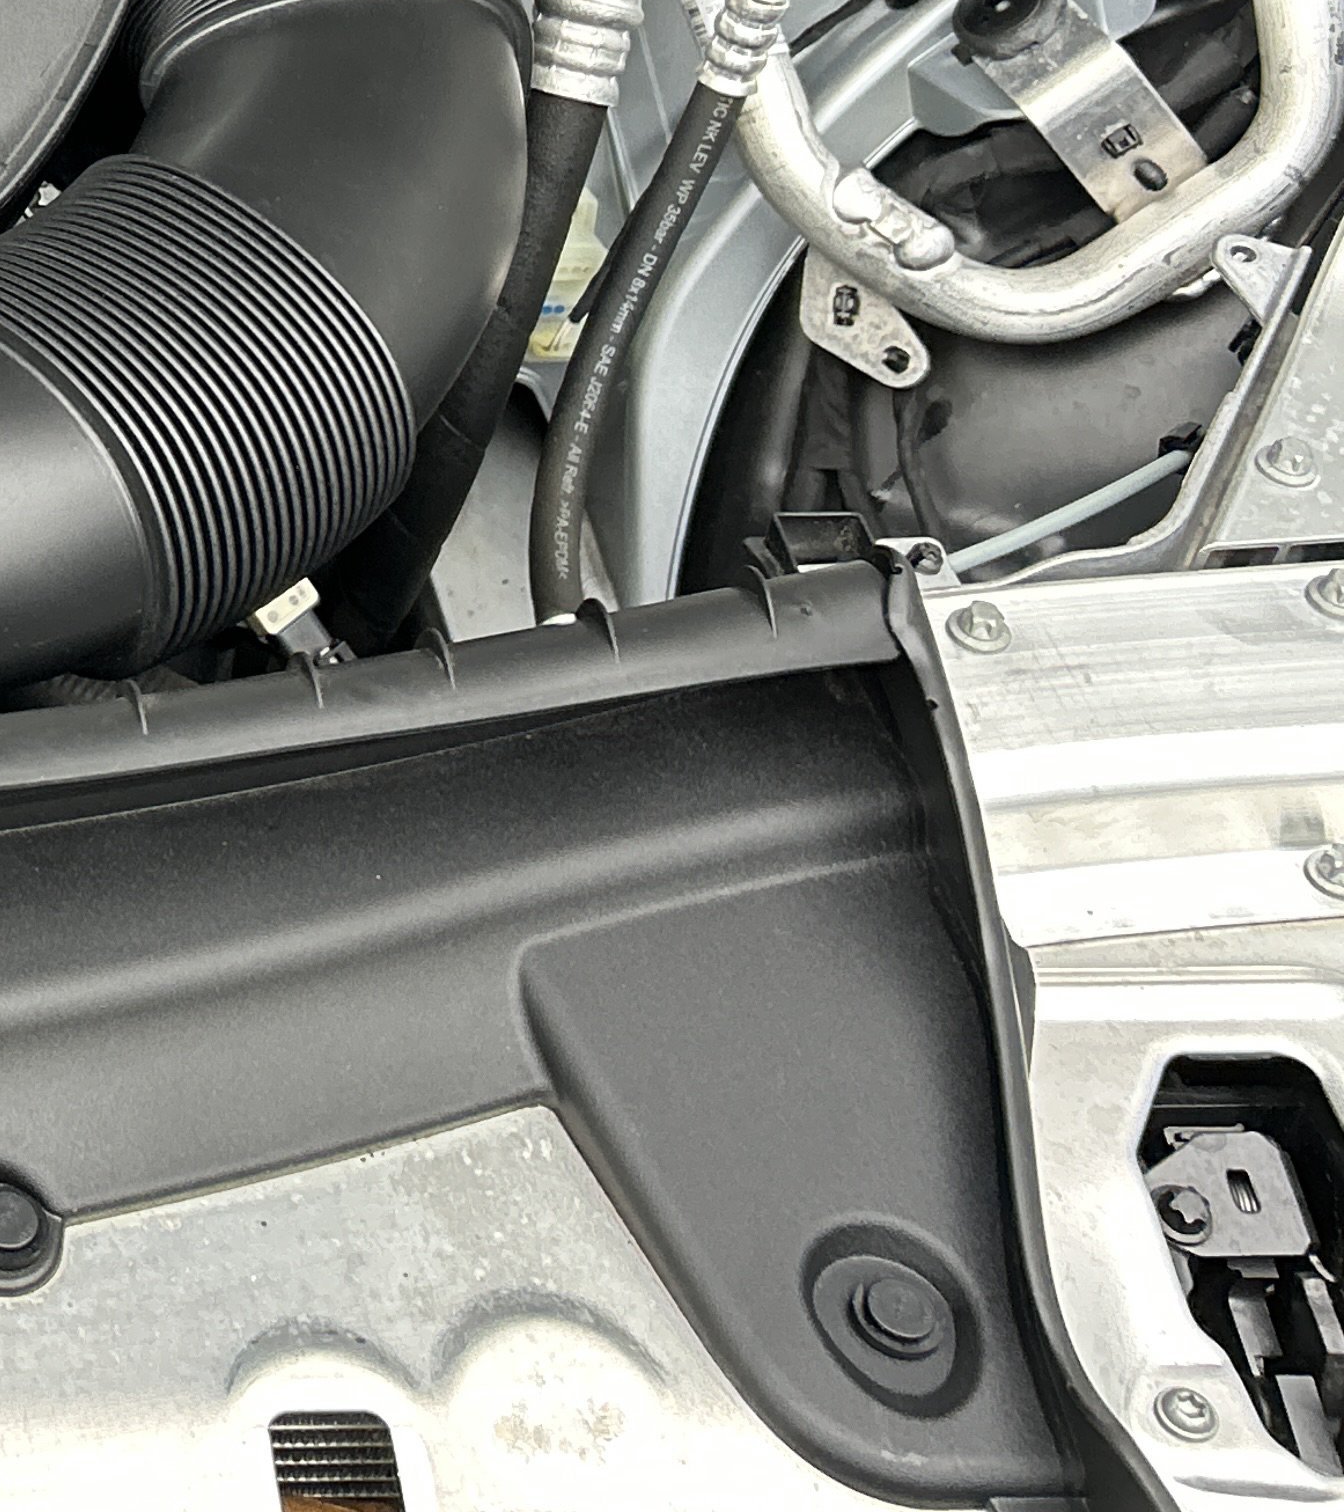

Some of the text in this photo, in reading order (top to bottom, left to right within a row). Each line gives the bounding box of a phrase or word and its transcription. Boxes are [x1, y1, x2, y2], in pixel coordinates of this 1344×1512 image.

[702, 119, 722, 143] NK
[689, 143, 712, 174] LEV
[676, 179, 695, 205] WP
[637, 253, 658, 277] DN
[593, 344, 616, 377] SAE
